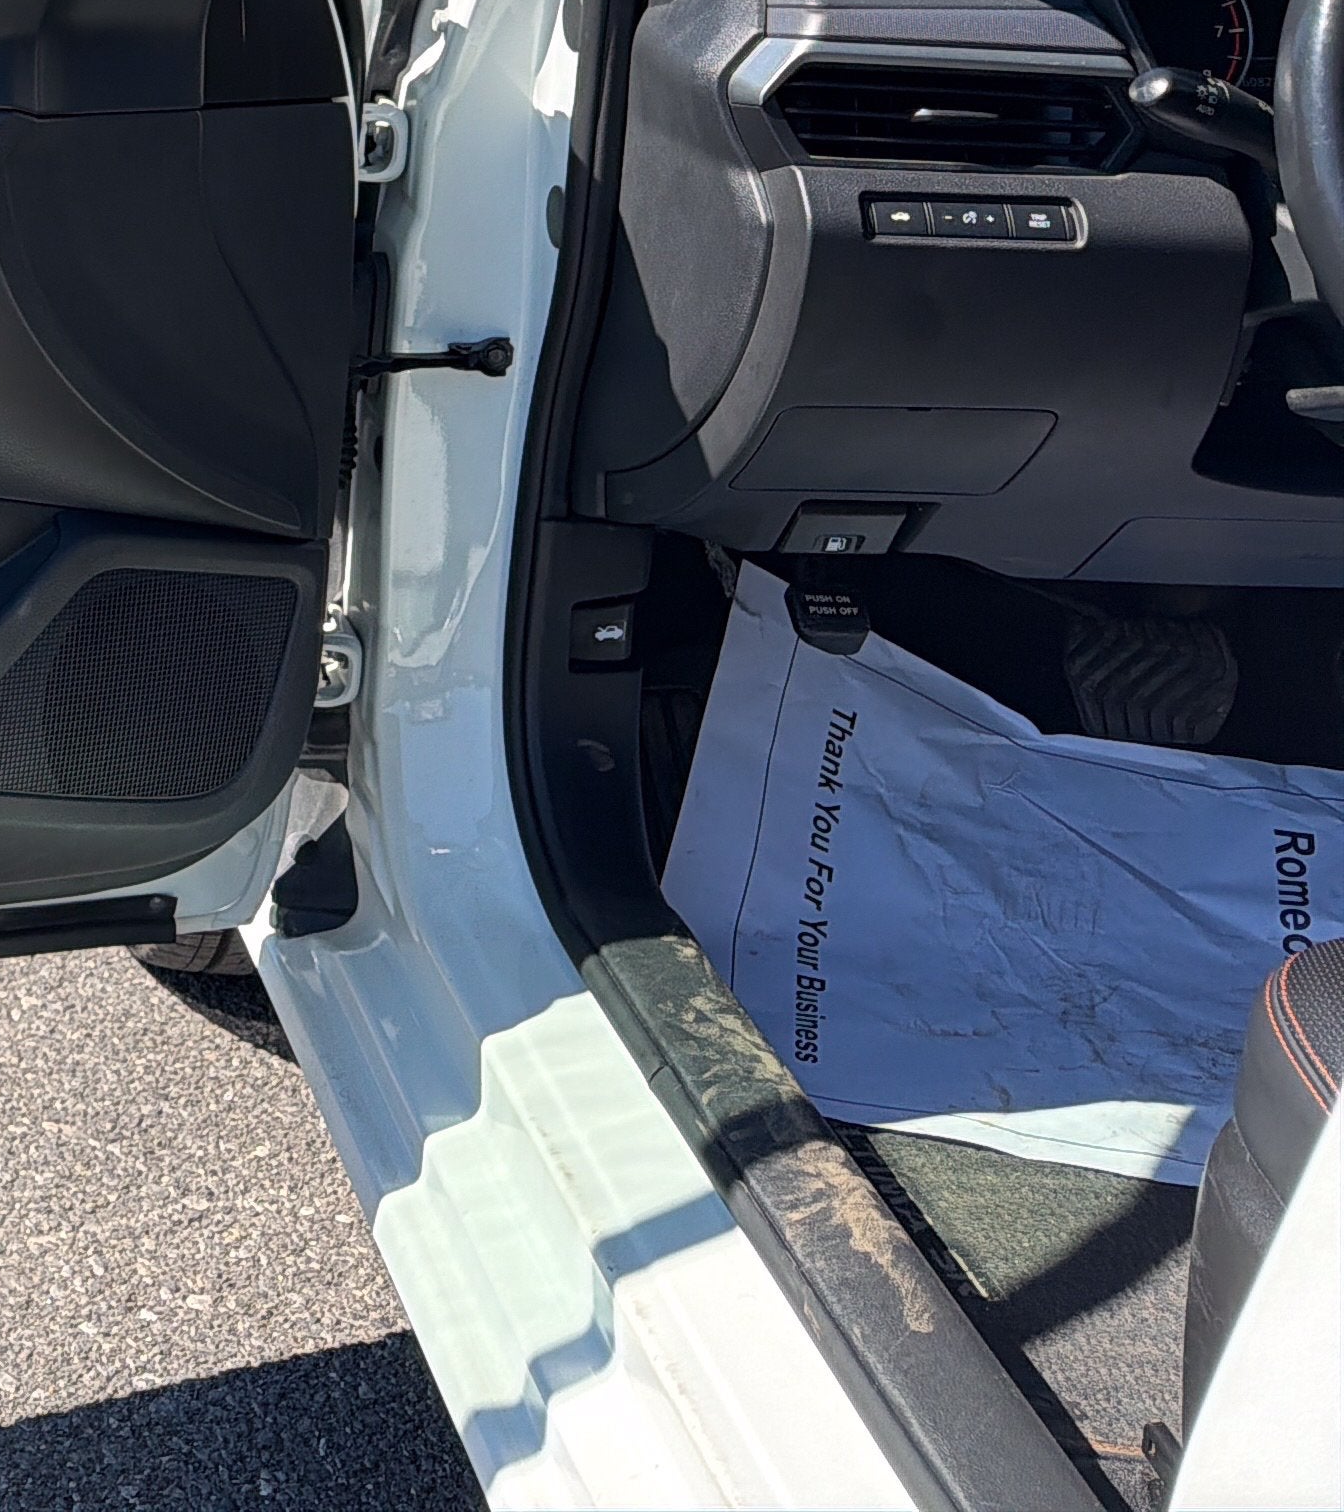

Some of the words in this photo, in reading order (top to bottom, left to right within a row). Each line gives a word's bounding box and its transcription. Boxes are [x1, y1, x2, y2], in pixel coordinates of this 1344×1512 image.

[1214, 25, 1224, 38] 7
[805, 594, 833, 603] PUSH
[835, 595, 851, 603] ON
[808, 606, 837, 615] PUSH
[839, 607, 859, 616] OFF
[818, 707, 858, 795] Thank
[810, 802, 841, 853] You
[803, 856, 834, 912] For
[796, 919, 829, 971] Your
[794, 974, 826, 1064] Business
